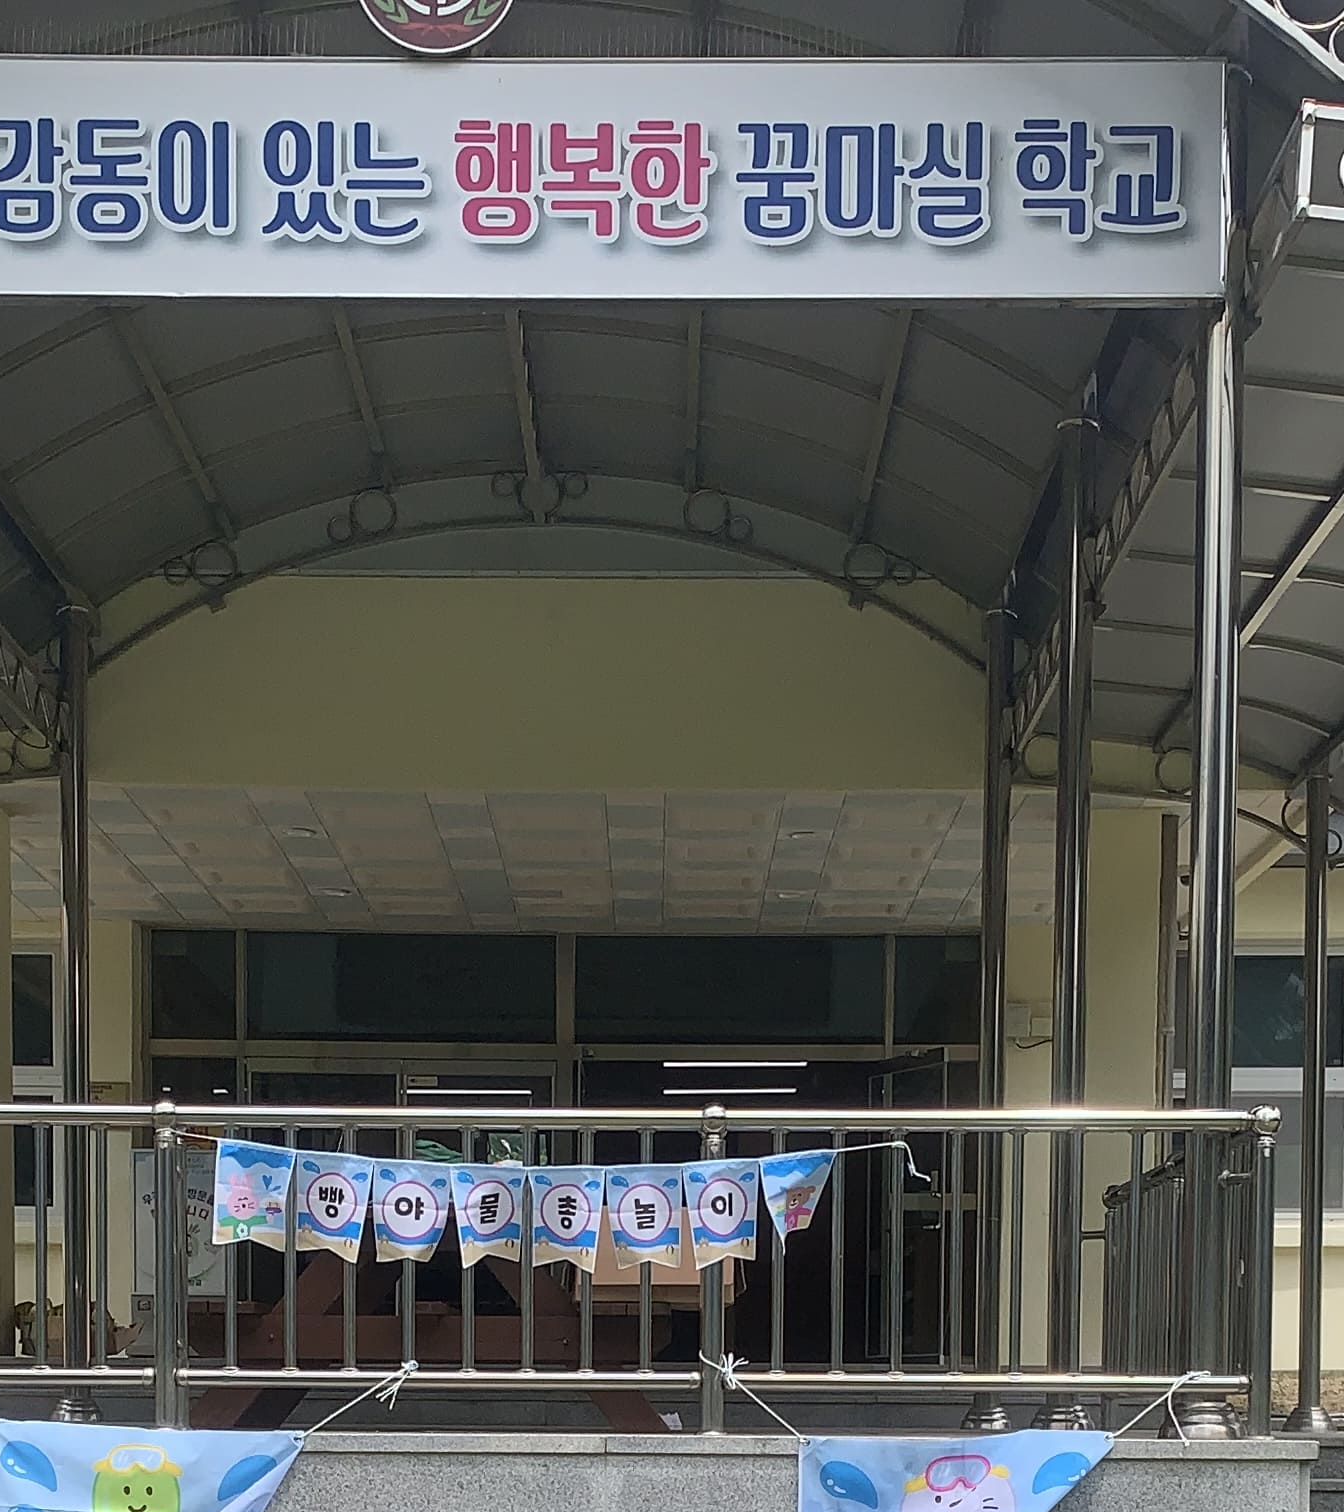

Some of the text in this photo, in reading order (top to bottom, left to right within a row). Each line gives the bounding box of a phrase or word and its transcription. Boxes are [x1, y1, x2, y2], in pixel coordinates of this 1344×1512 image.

[261, 121, 427, 238] 있는
[454, 119, 711, 238] 행복한
[736, 121, 985, 239] 꿈마실
[1014, 118, 1182, 236] 학교
